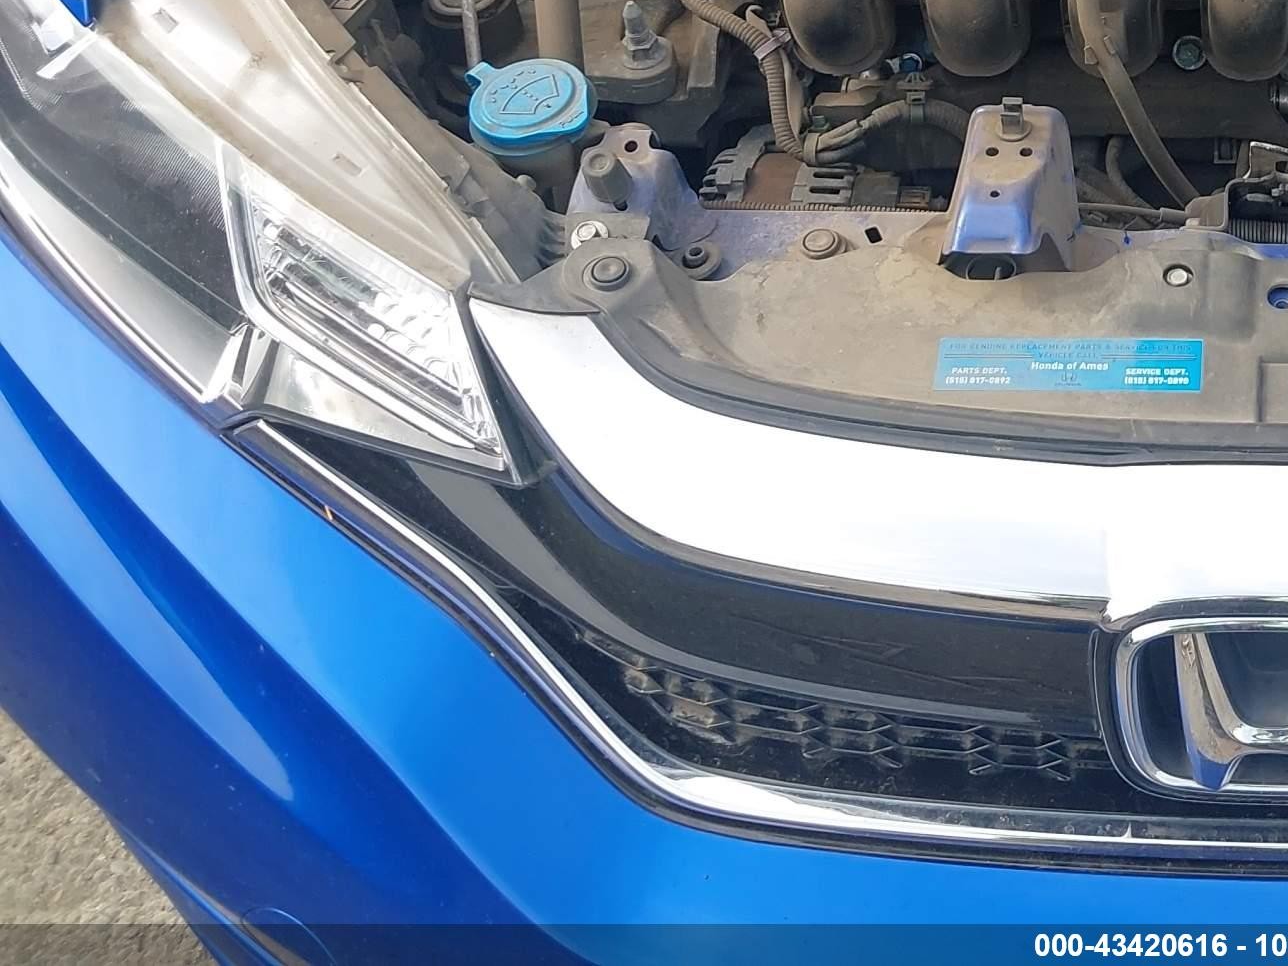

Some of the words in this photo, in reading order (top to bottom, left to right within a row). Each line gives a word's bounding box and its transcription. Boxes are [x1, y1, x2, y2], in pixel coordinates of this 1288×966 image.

[1075, 343, 1102, 351] PARTS
[1031, 361, 1063, 370] Honda
[1067, 361, 1077, 370] of
[1079, 362, 1109, 371] Ames
[951, 367, 980, 375] PARTS
[982, 367, 1008, 375] DEPT.
[1163, 368, 1189, 376] DEPT.
